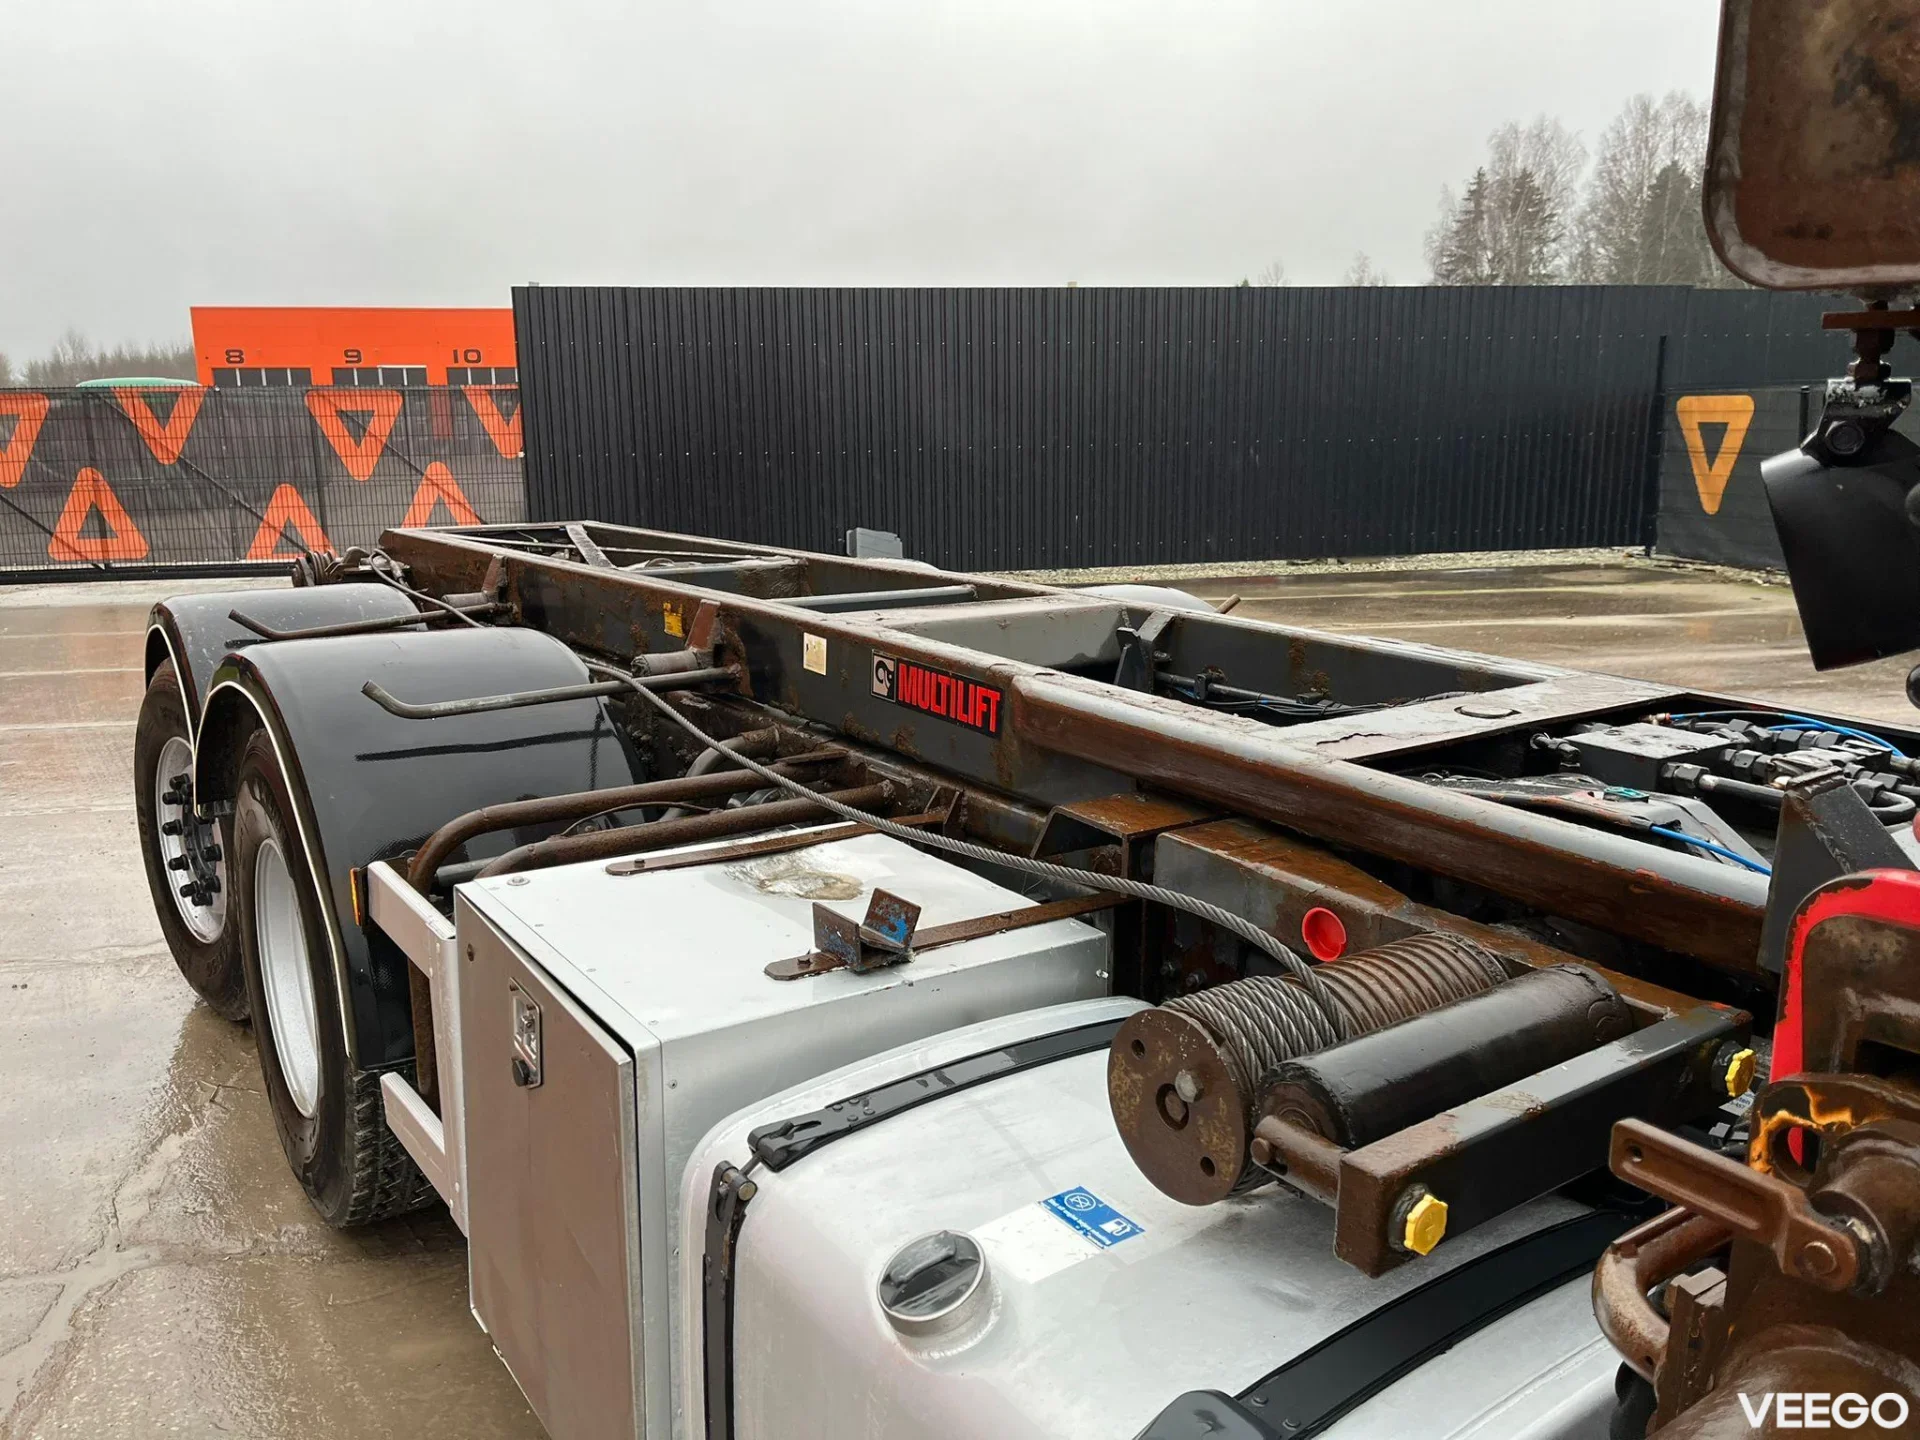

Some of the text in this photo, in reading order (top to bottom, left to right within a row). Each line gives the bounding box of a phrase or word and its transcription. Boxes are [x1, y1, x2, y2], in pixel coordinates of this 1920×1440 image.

[225, 349, 245, 364] 8
[343, 349, 362, 364] 9
[452, 349, 482, 364] 10
[898, 662, 1000, 733] MULTILIFT
